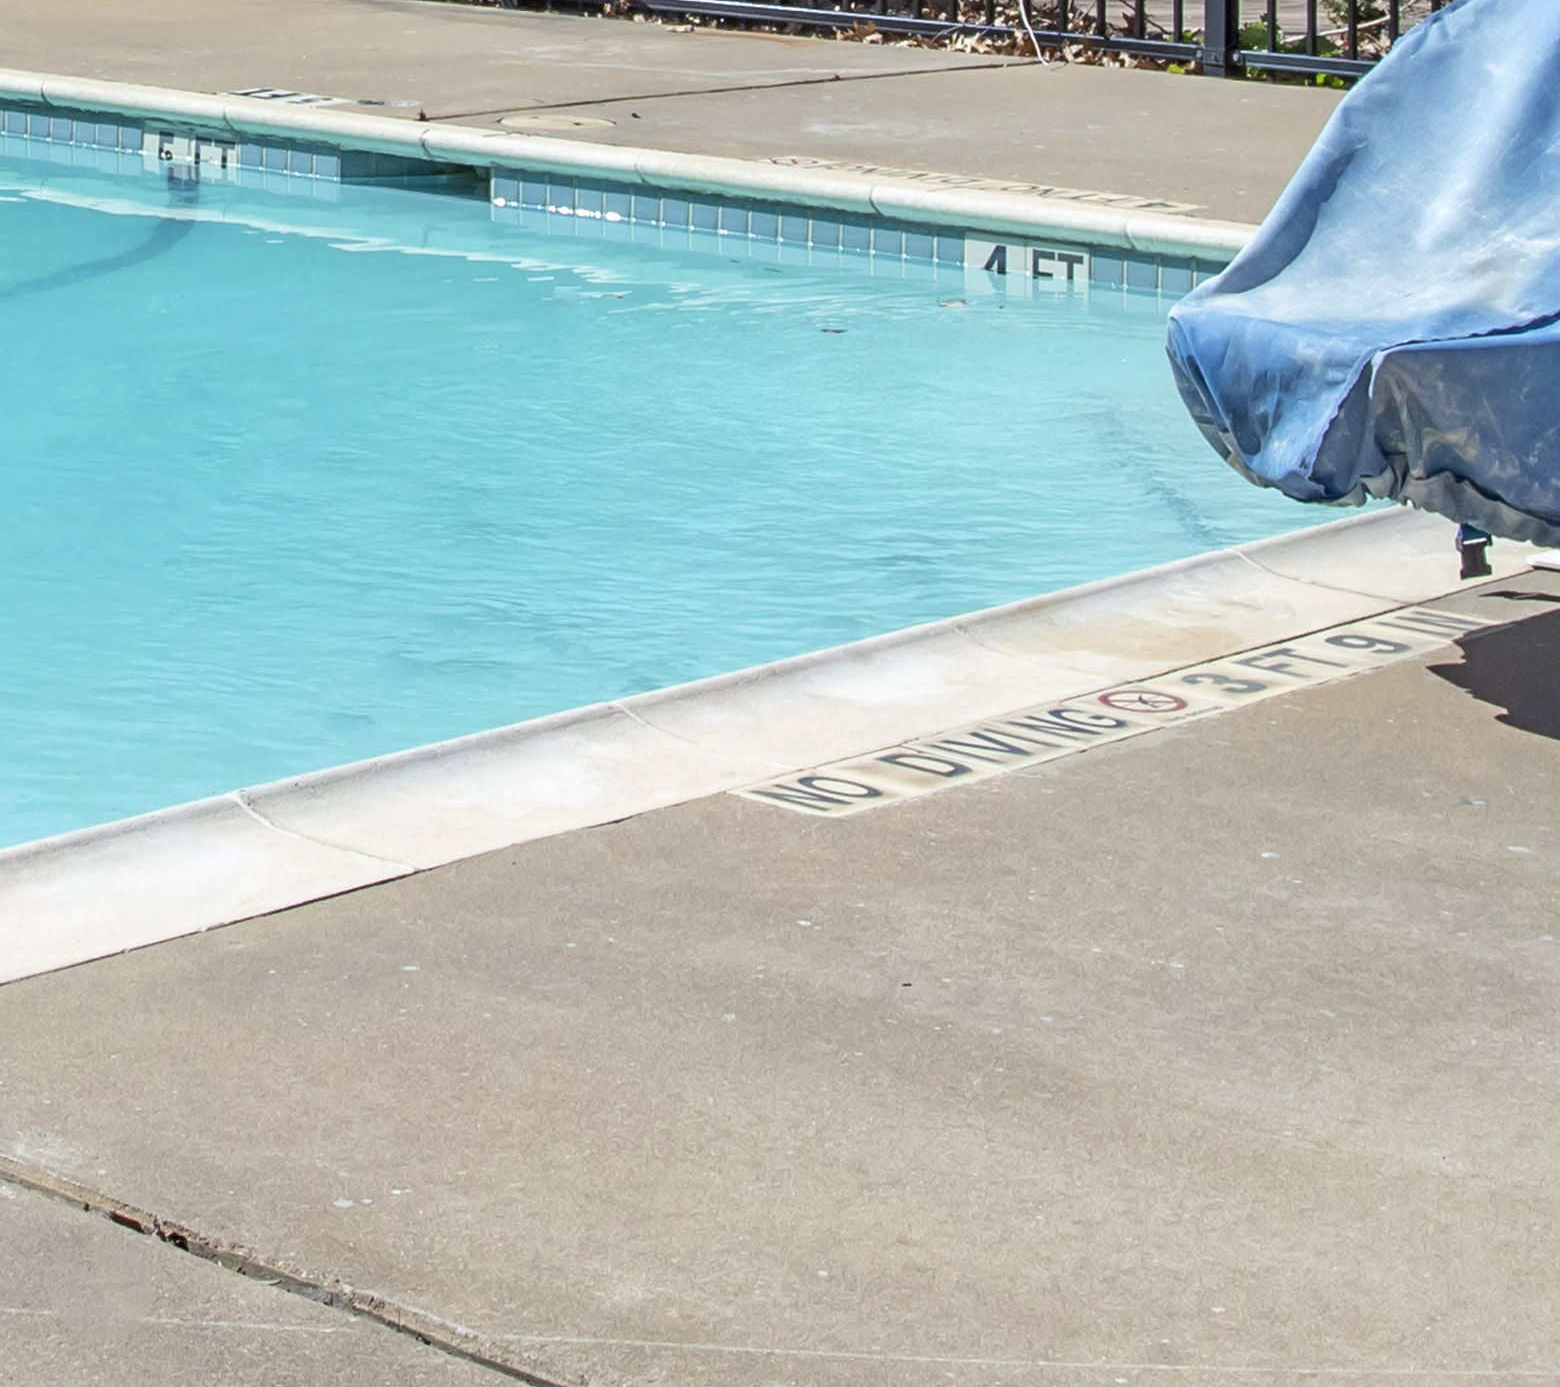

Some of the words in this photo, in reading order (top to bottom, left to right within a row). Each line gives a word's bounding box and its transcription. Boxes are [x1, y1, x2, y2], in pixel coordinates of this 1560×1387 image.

[195, 135, 236, 169] FT
[1032, 248, 1084, 280] FT
[752, 775, 884, 812] NO
[875, 708, 1130, 777] DIVING
[1180, 672, 1268, 695] 3
[1233, 647, 1349, 679] FT
[1324, 633, 1413, 655] 9
[1376, 610, 1482, 639] IN
